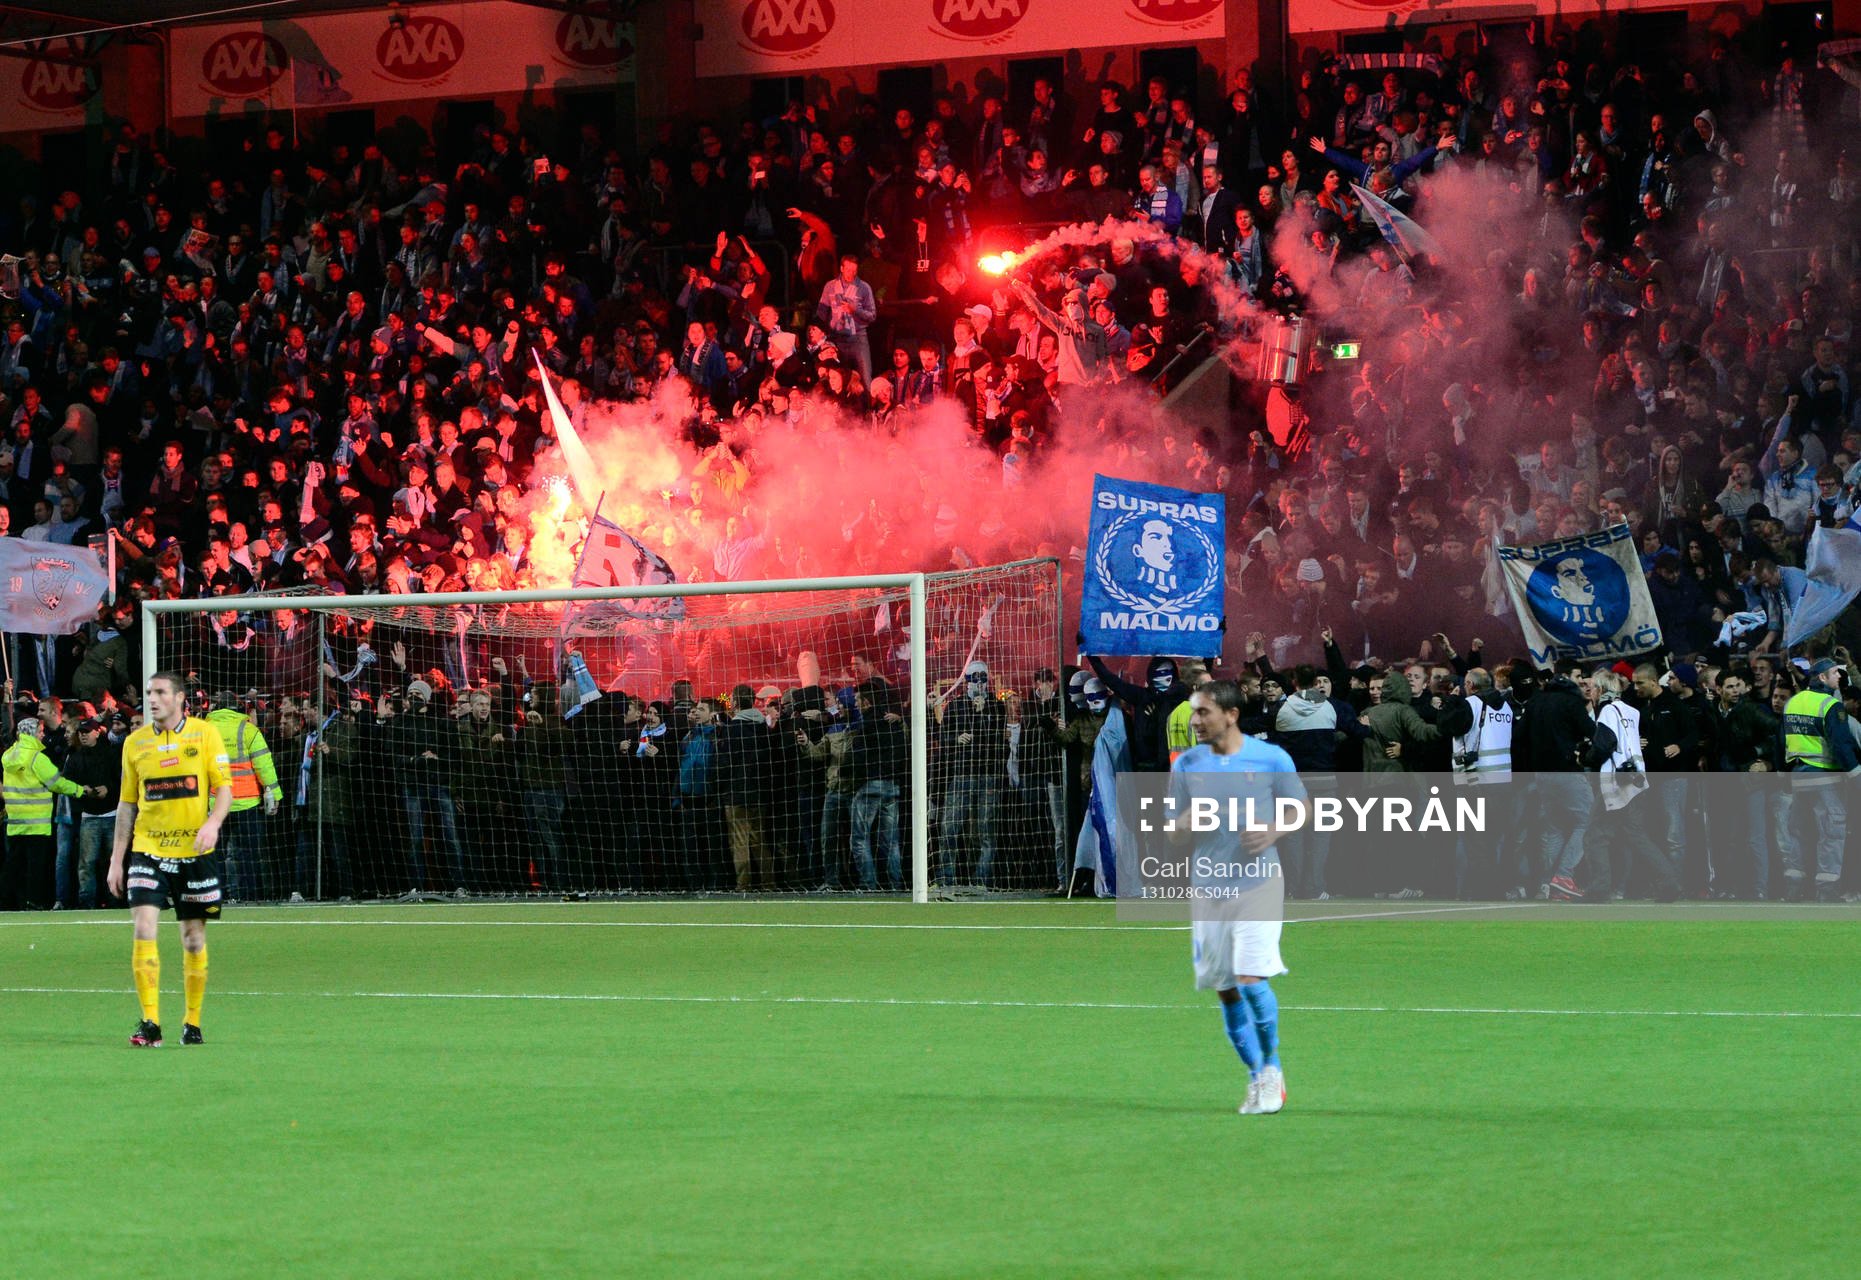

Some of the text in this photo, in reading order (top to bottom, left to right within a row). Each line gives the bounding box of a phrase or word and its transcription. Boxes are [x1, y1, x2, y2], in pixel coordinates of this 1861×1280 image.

[750, 0, 828, 38] AXA
[384, 24, 457, 67] AXA
[564, 13, 636, 52] AXA
[210, 39, 280, 80] AXA
[1097, 491, 1218, 524] SUPRAS
[1100, 612, 1219, 632] MALMÖ
[1489, 712, 1512, 723] FOTO
[147, 828, 201, 839] TOVEKS
[160, 839, 181, 848] BIL
[159, 862, 180, 874] BIL
